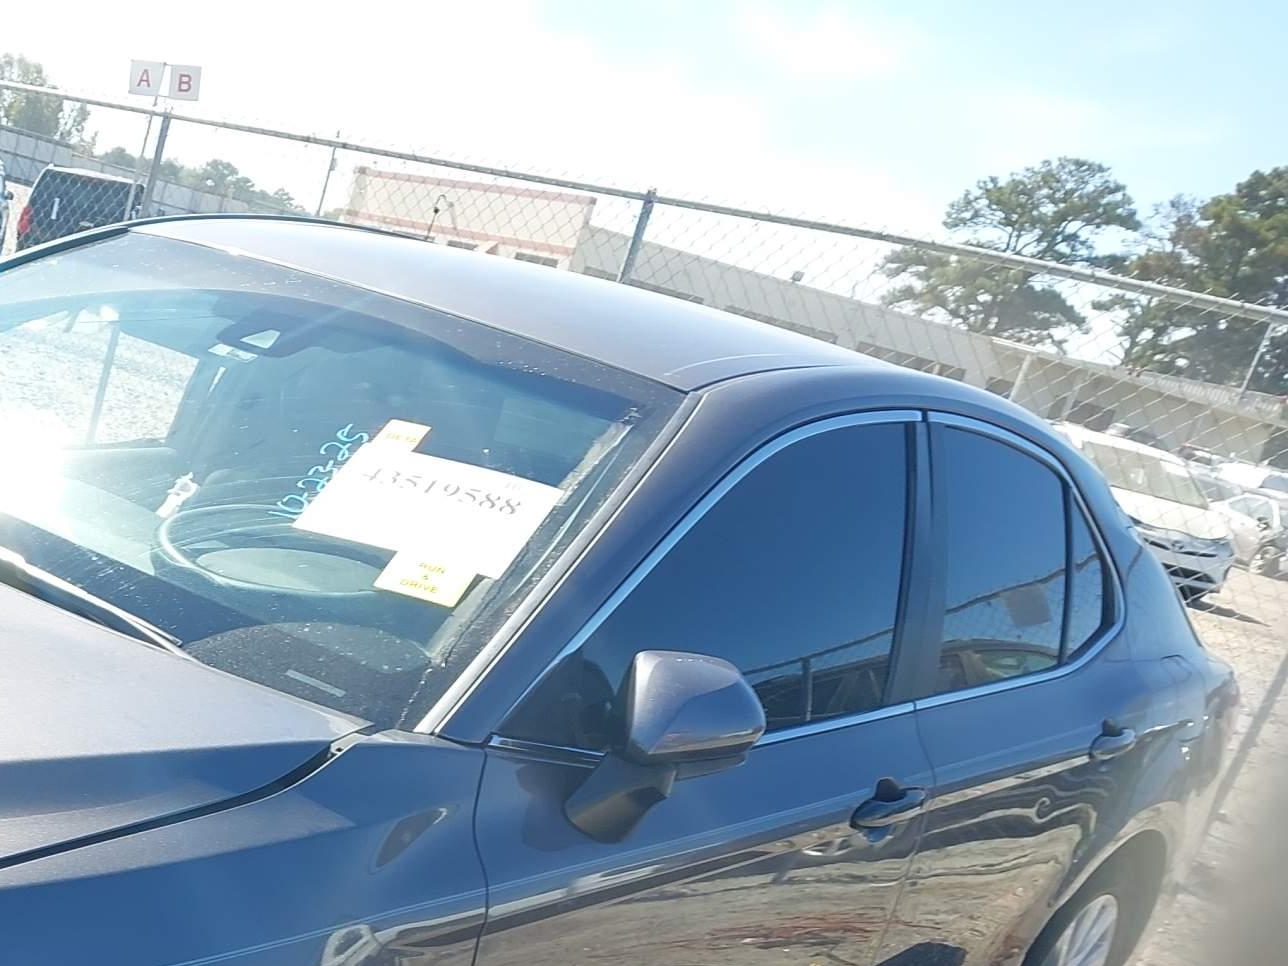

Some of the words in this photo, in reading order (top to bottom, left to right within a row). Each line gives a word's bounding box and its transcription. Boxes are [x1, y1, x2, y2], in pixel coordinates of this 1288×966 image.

[136, 68, 151, 88] A
[177, 73, 193, 93] B
[362, 467, 522, 515] 43519588
[399, 578, 439, 594] DRIVE
